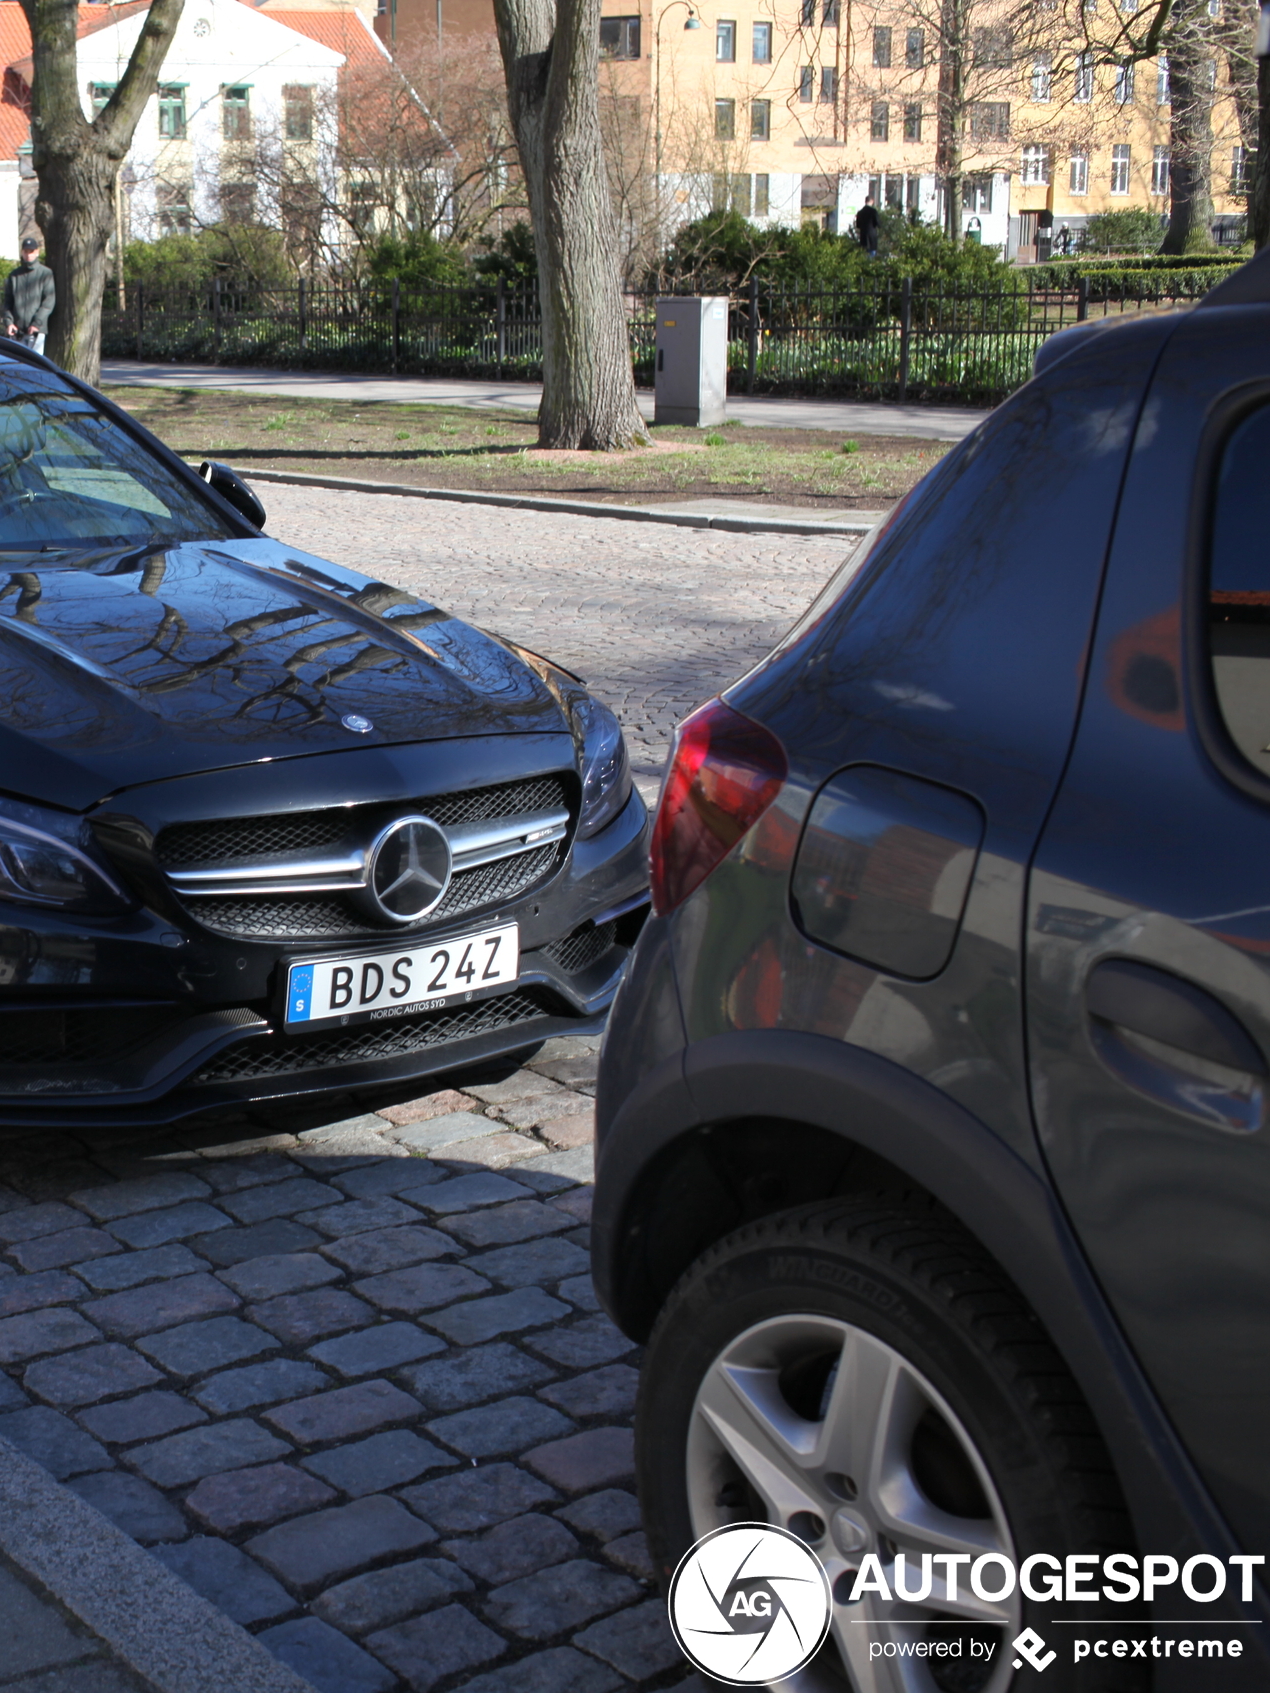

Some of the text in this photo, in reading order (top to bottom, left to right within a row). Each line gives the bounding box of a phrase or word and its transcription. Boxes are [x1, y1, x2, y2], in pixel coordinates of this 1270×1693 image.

[329, 935, 502, 1010] BDS 24Z
[295, 999, 305, 1012] S
[370, 998, 446, 1021] NORDIC AUTOS SYD
[768, 1255, 900, 1309] WINGUARD
